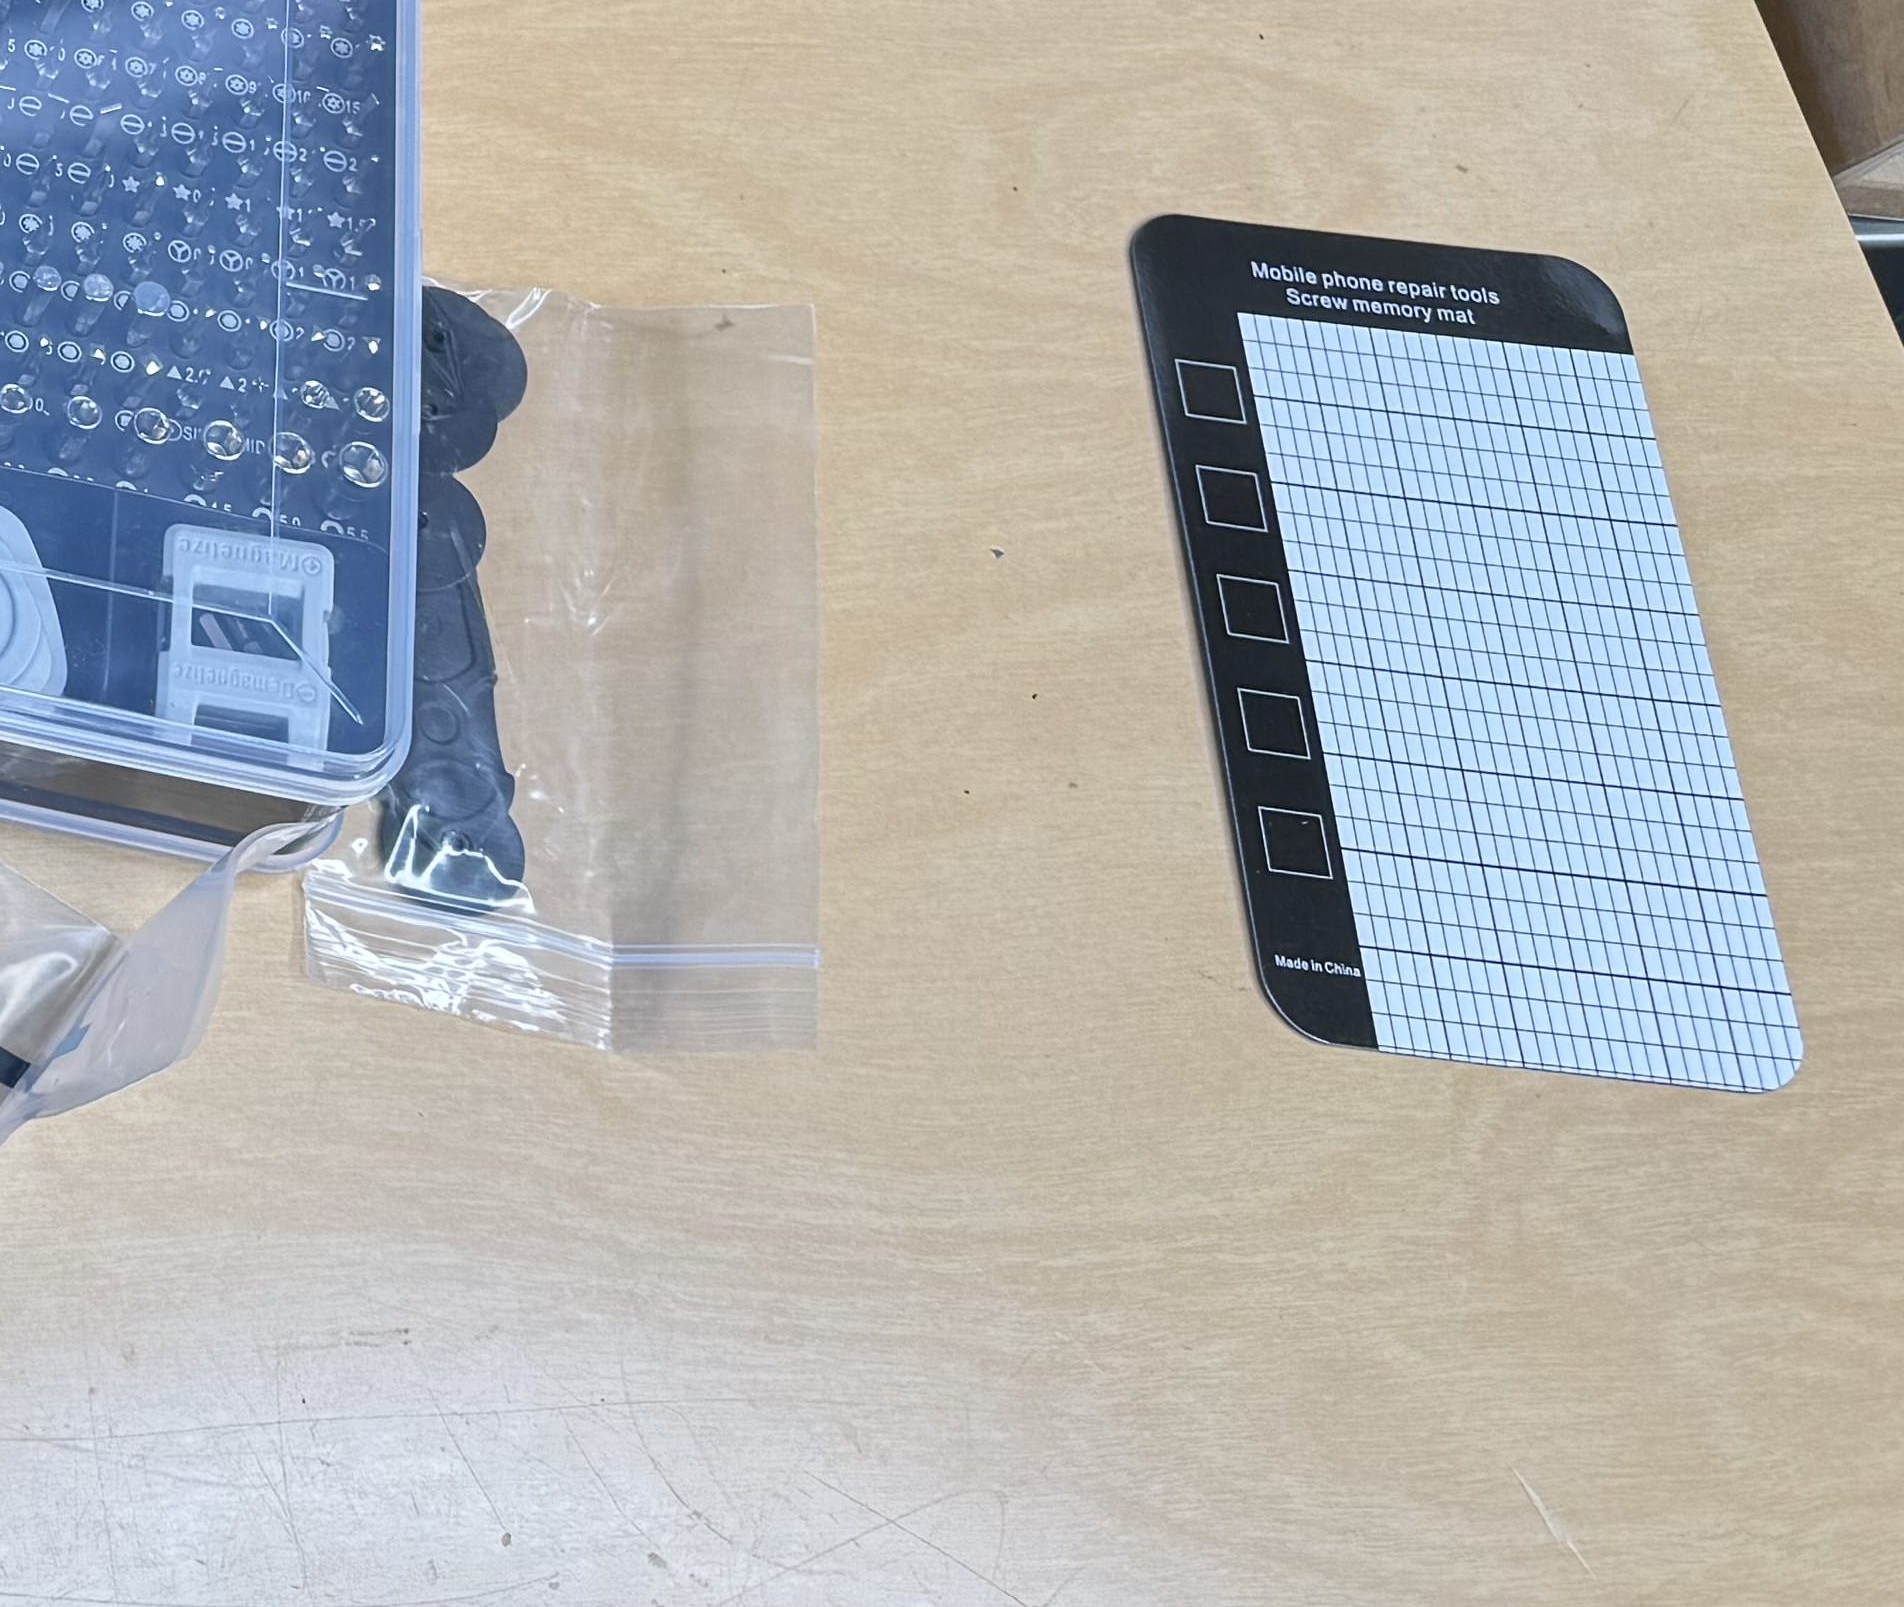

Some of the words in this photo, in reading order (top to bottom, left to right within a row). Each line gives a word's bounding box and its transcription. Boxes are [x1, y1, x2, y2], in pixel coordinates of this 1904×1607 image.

[1250, 261, 1317, 285] Mobile
[1322, 270, 1383, 293] phone
[1388, 279, 1446, 299] repair
[1450, 285, 1501, 305] tools
[1286, 288, 1348, 311] Screw
[1353, 299, 1432, 323] memory
[1437, 307, 1477, 325] mat
[179, 537, 301, 572] Magnetize
[1274, 954, 1309, 971] Made
[1311, 959, 1323, 972] in
[1324, 961, 1362, 978] China
